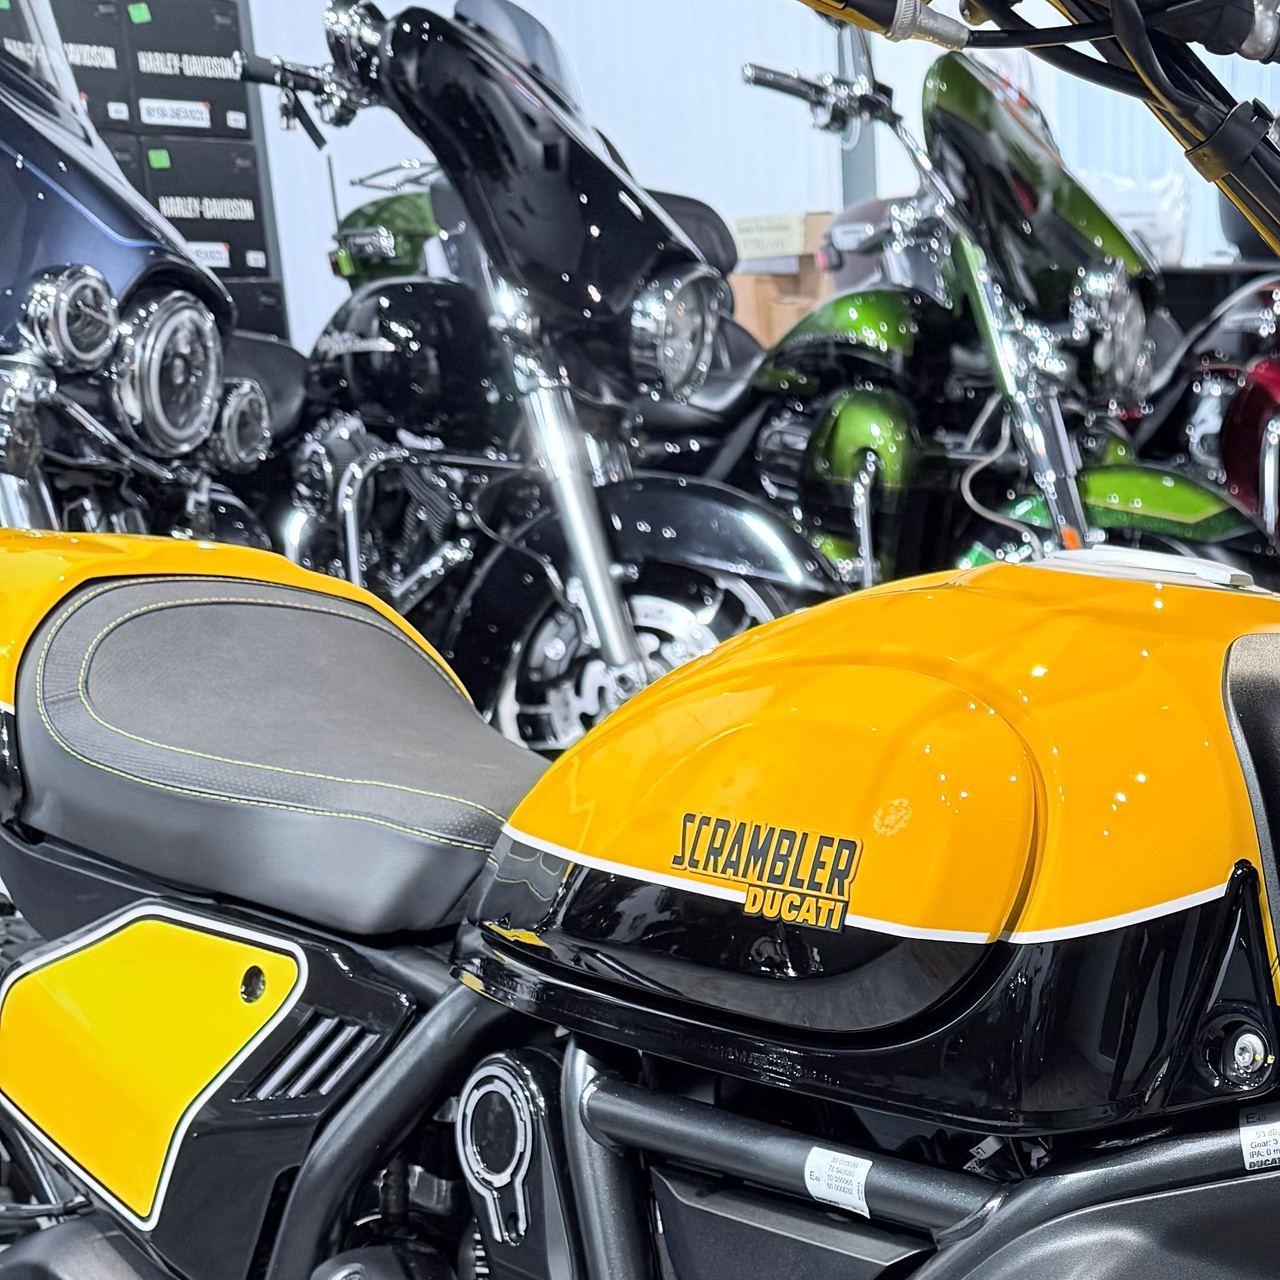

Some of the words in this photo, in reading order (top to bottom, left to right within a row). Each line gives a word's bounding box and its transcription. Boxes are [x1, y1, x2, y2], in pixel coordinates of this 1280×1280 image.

[159, 196, 255, 220] HARLEY-DAVIDSON
[671, 812, 861, 898] SCRAMBLER
[743, 887, 844, 931] DUCATI
